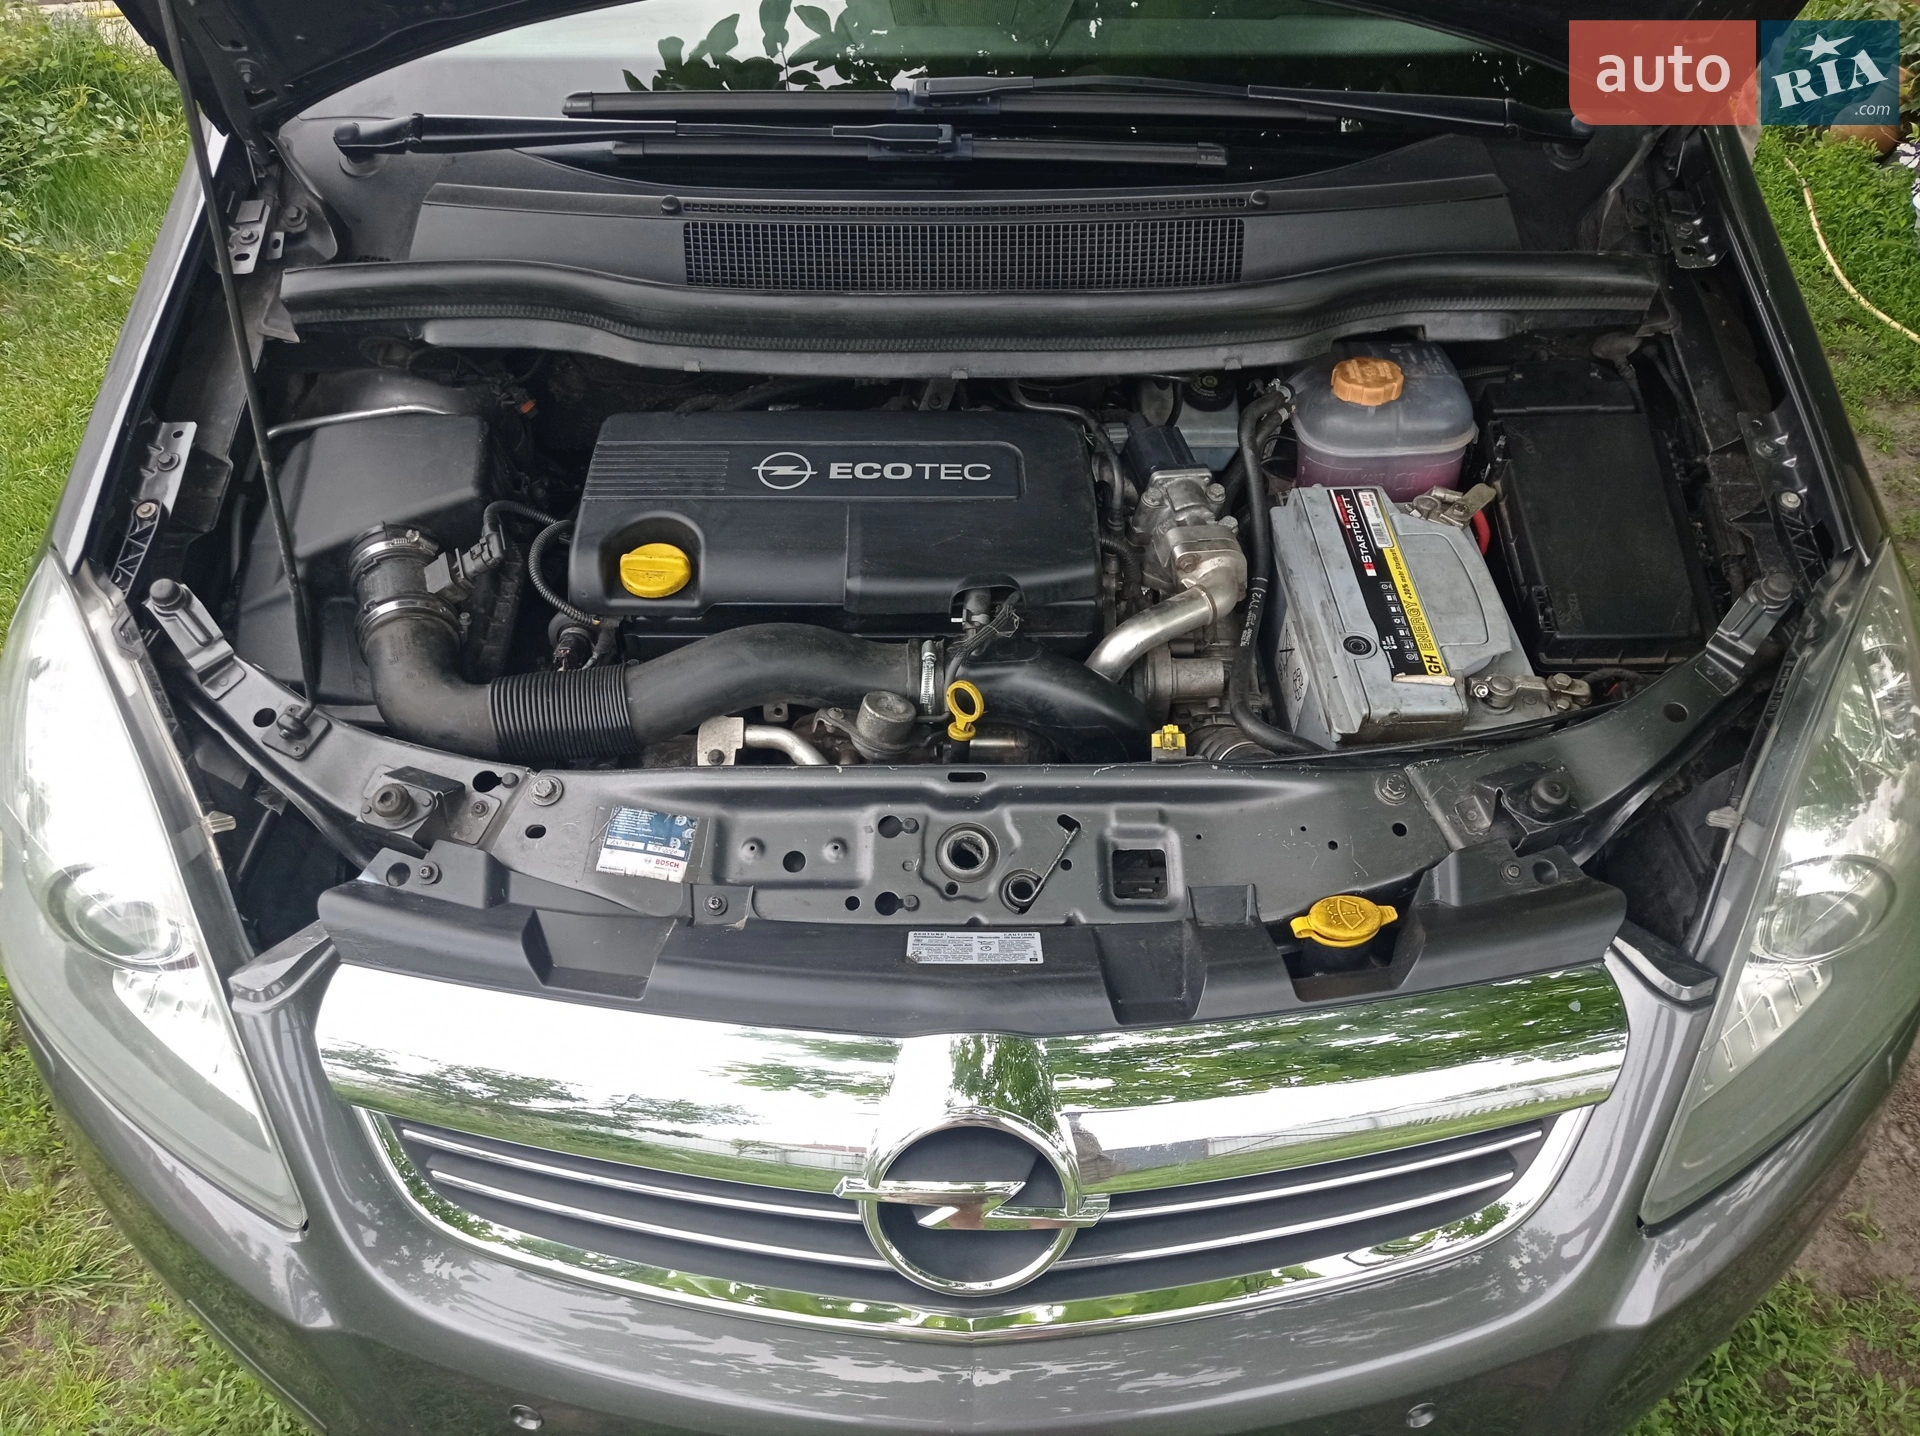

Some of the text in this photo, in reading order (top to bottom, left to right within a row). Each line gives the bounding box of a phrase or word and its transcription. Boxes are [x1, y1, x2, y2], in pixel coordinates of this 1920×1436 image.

[829, 461, 992, 482] ECOTEC
[1342, 494, 1372, 563] STARTCRAFT
[1404, 600, 1434, 651] ENERGY
[655, 858, 680, 868] BOSCH
